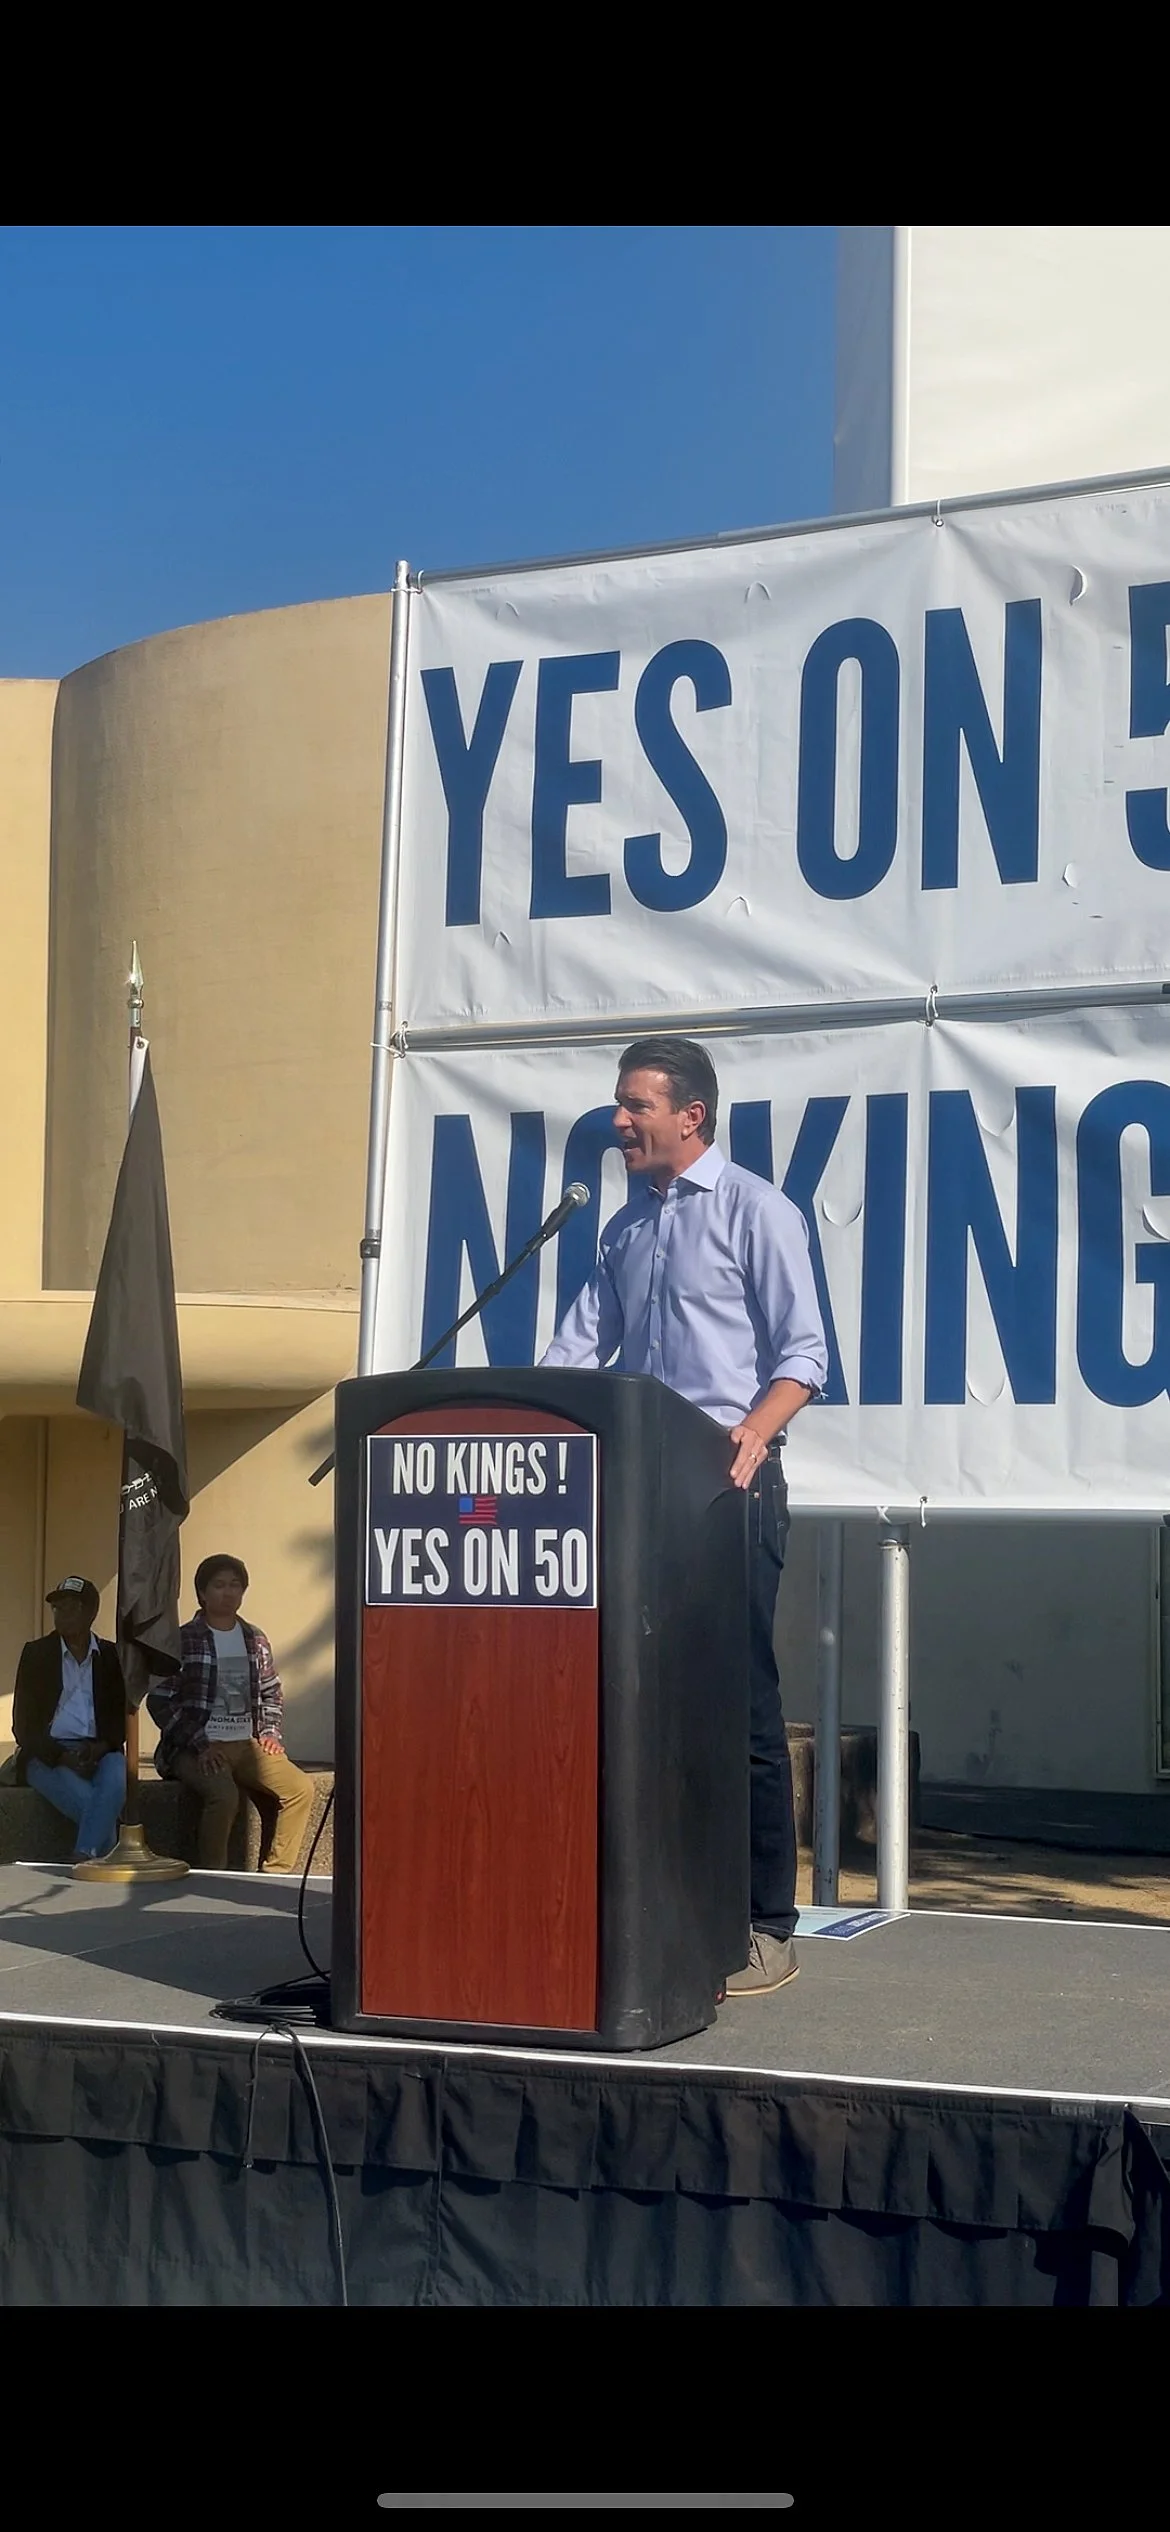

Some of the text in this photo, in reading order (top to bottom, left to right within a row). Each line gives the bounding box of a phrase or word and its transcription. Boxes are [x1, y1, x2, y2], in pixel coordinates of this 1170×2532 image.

[420, 639, 732, 927] YES
[797, 598, 1042, 900] ON
[393, 1442, 436, 1495] NO
[447, 1441, 547, 1495] KINGS
[129, 1492, 151, 1511] ARE
[374, 1528, 588, 1598] YES ON 50
